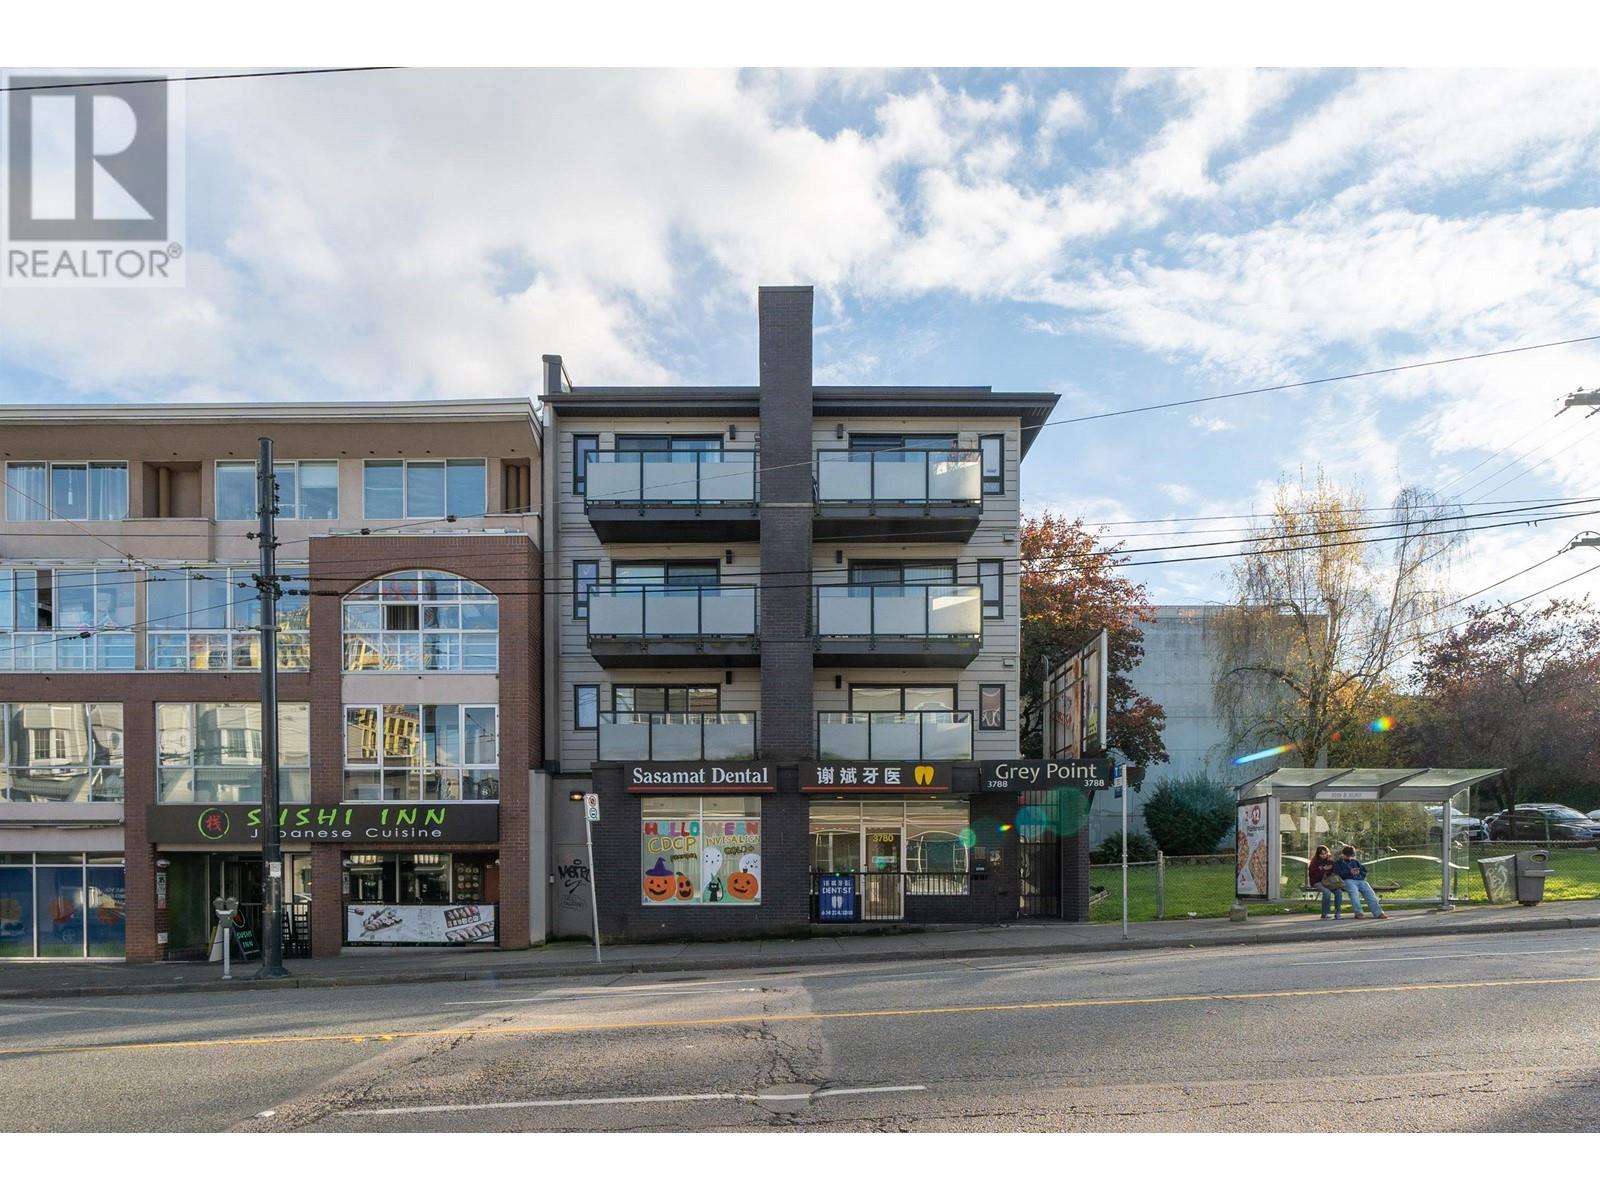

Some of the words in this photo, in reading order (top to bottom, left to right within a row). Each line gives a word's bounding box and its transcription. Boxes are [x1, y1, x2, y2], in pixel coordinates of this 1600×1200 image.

[633, 767, 706, 784] Sasamat
[711, 767, 769, 784] Dental
[816, 767, 902, 785] 谢斌牙医
[995, 763, 1041, 783] Grey
[1047, 762, 1097, 779] Point
[987, 780, 1009, 788] 3788
[1084, 779, 1105, 787] 3788
[381, 807, 446, 825] INN
[365, 828, 442, 838] Cuisine
[872, 833, 894, 842] 3780
[648, 836, 697, 854] CDCP
